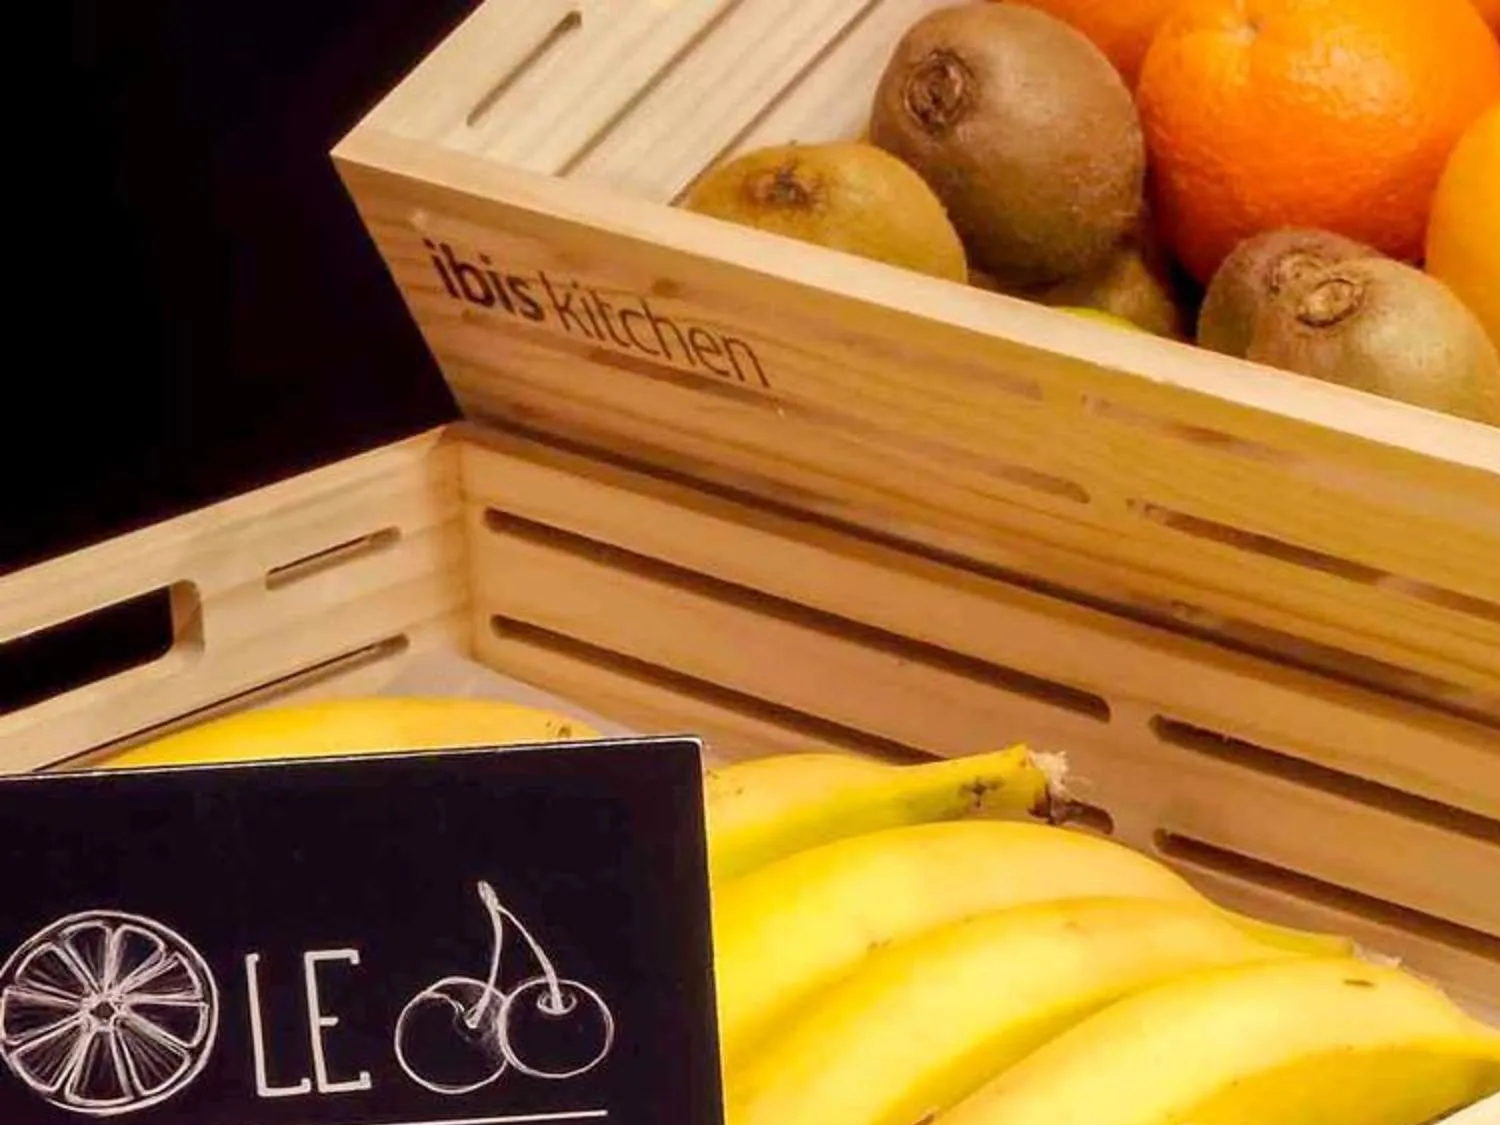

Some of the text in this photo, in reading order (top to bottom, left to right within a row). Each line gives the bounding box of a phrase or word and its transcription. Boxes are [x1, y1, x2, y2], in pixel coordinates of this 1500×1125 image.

[421, 238, 771, 389] ibis kitchen
[246, 948, 372, 1097] LE
